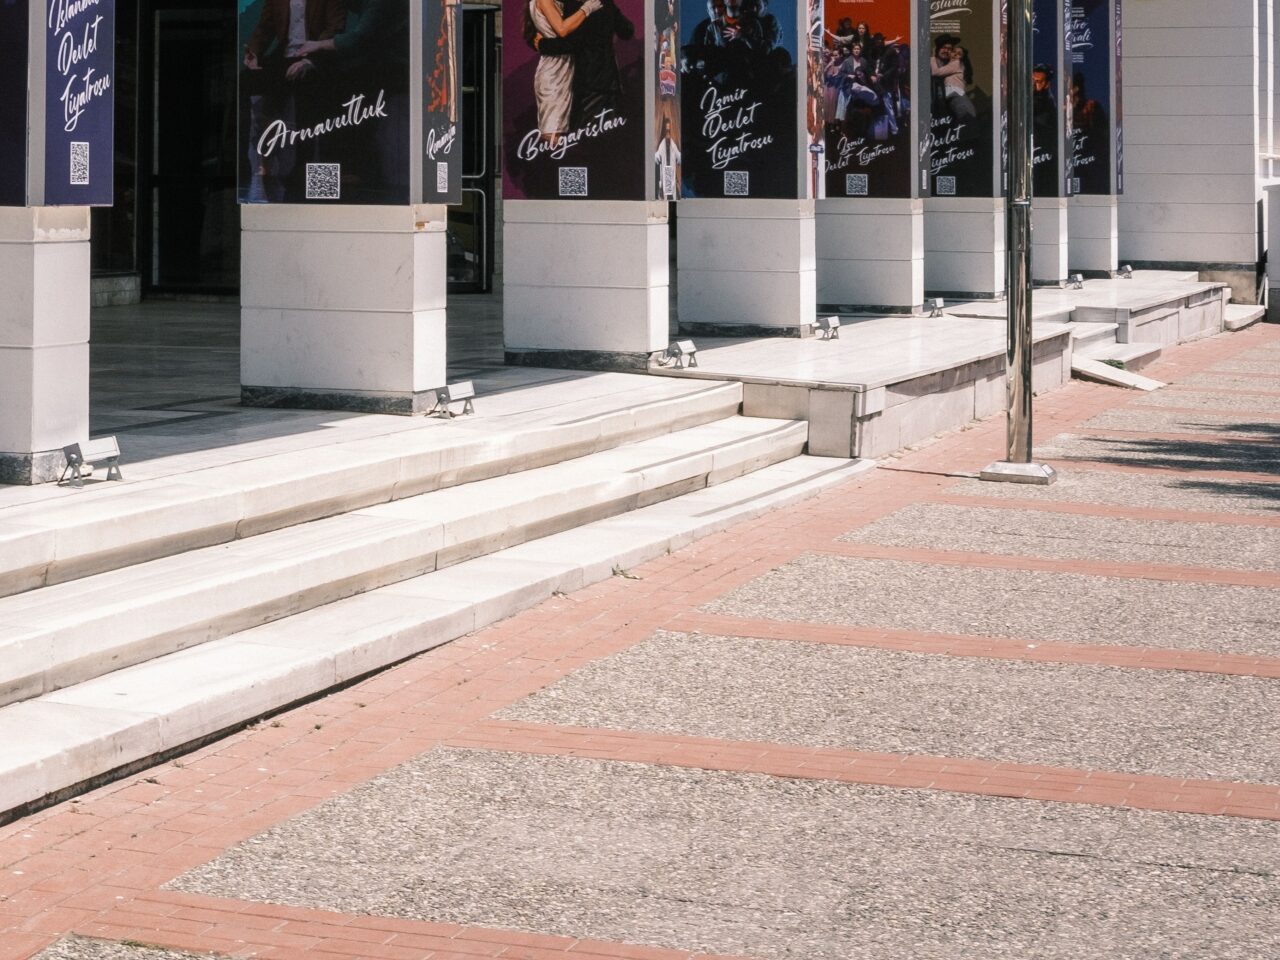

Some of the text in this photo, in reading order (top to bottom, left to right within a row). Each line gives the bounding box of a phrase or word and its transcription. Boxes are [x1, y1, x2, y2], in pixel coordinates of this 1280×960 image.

[57, 14, 103, 75] Devlet
[60, 67, 111, 132] Tiyatrosu
[257, 89, 388, 157] Arnavutluk
[703, 102, 762, 138] Devlet
[930, 113, 952, 127] ivas
[517, 108, 627, 161] Bulgaristan
[706, 132, 773, 169] Tiyatrosu
